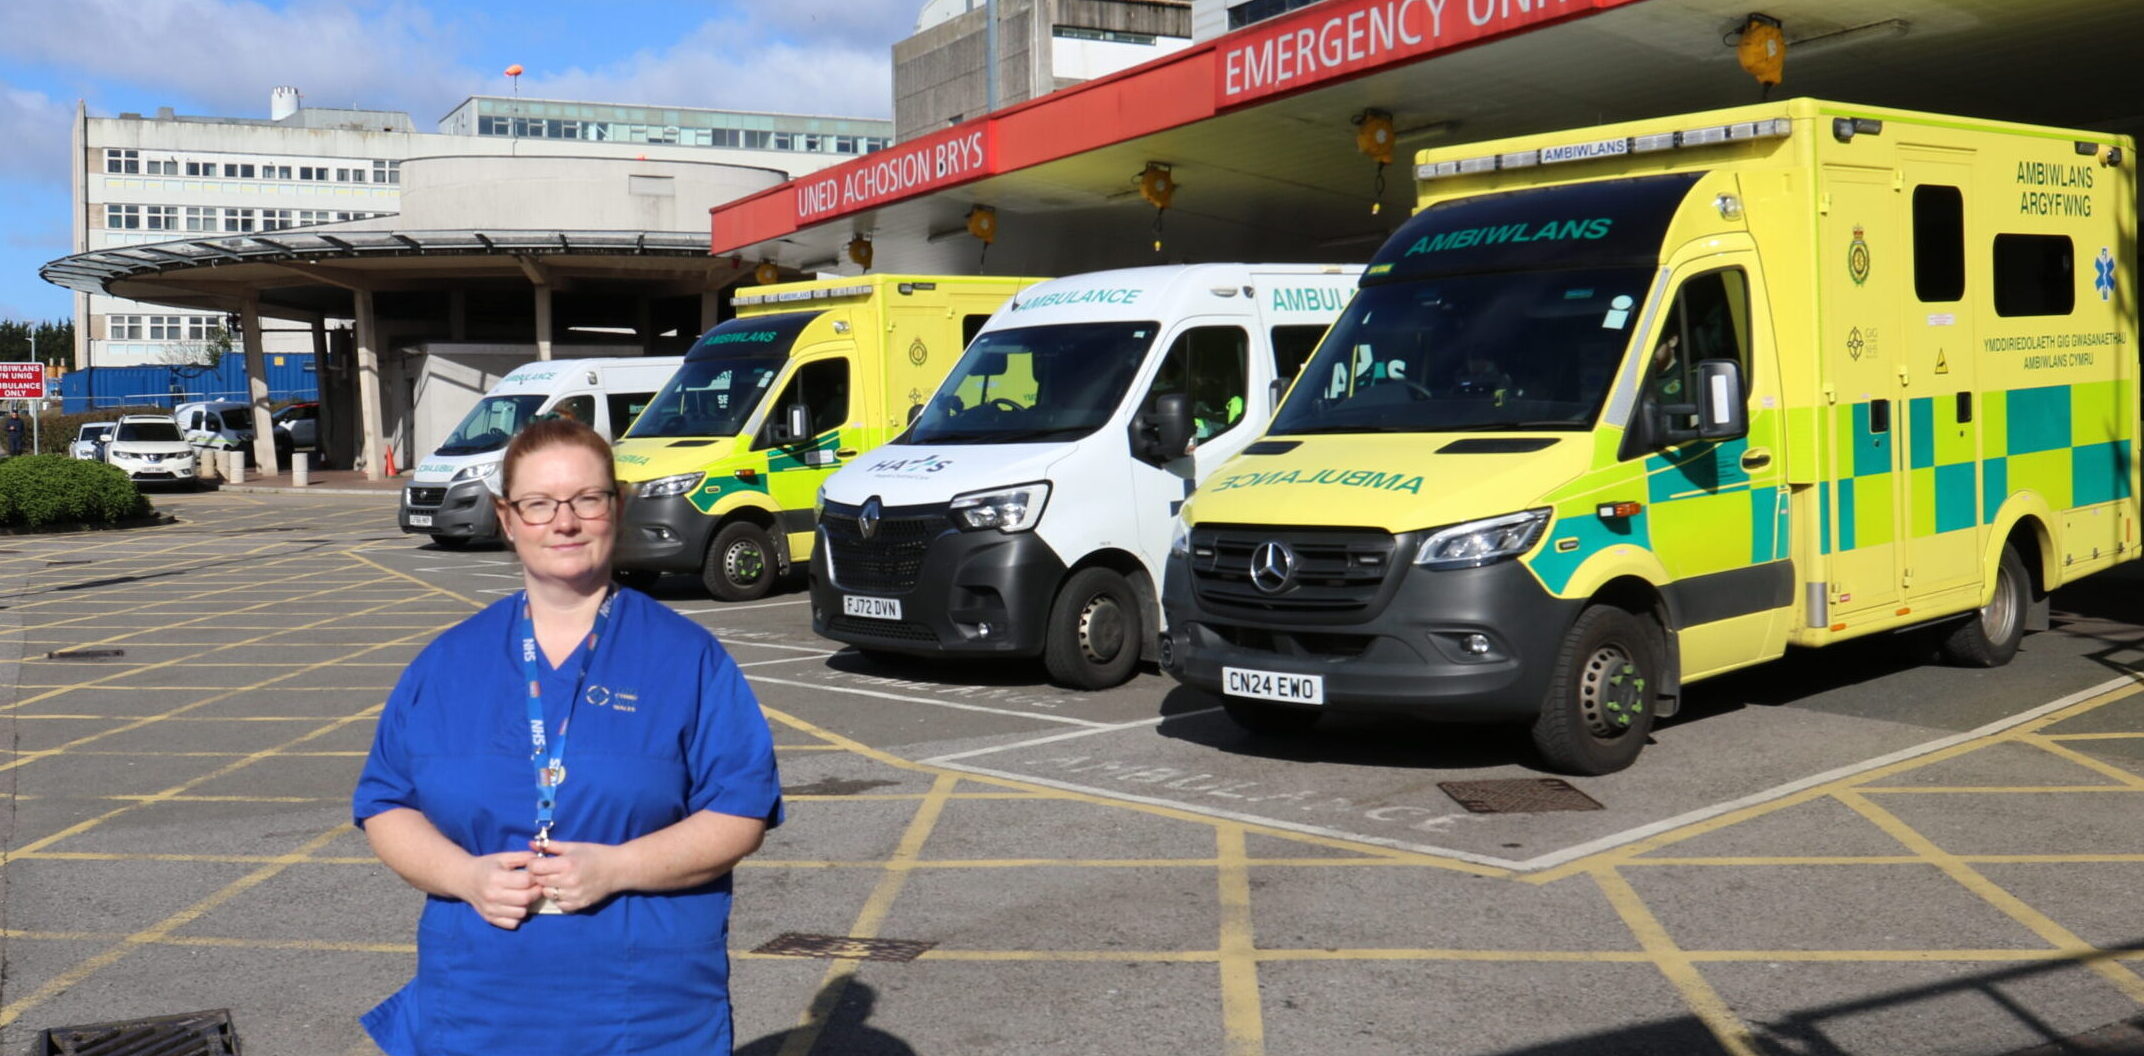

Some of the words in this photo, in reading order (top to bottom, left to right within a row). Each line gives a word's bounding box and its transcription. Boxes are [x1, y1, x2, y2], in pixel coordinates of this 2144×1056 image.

[1225, 0, 1446, 95] EMERGENCY
[1544, 140, 1625, 161] AMBIWLANS
[798, 178, 838, 217] UNED
[843, 148, 930, 206] ACHOSION
[936, 131, 984, 179] BRYS
[2016, 161, 2094, 189] AMBIWLANS
[2020, 191, 2092, 218] ARGYFWNG
[1404, 217, 1613, 257] AMBIWLANS
[1019, 289, 1142, 311] AMBULANCE
[1273, 287, 1356, 312] AMBUL
[704, 331, 779, 346] AMBIWLANS
[1984, 335, 2056, 351] YMDDIRIEDOLAETH
[2056, 334, 2070, 348] GIG
[2071, 331, 2127, 347] GWASANAETHAU
[2024, 354, 2068, 370] AMBIWLANS
[2068, 353, 2094, 366] CYMRU
[0, 382, 41, 390] BULANCE
[4, 389, 27, 397] ONLY
[847, 597, 872, 615] FJ72
[875, 600, 896, 616] DVN
[523, 638, 537, 662] NHS
[1230, 671, 1272, 695] CN24
[531, 719, 547, 746] NHS
